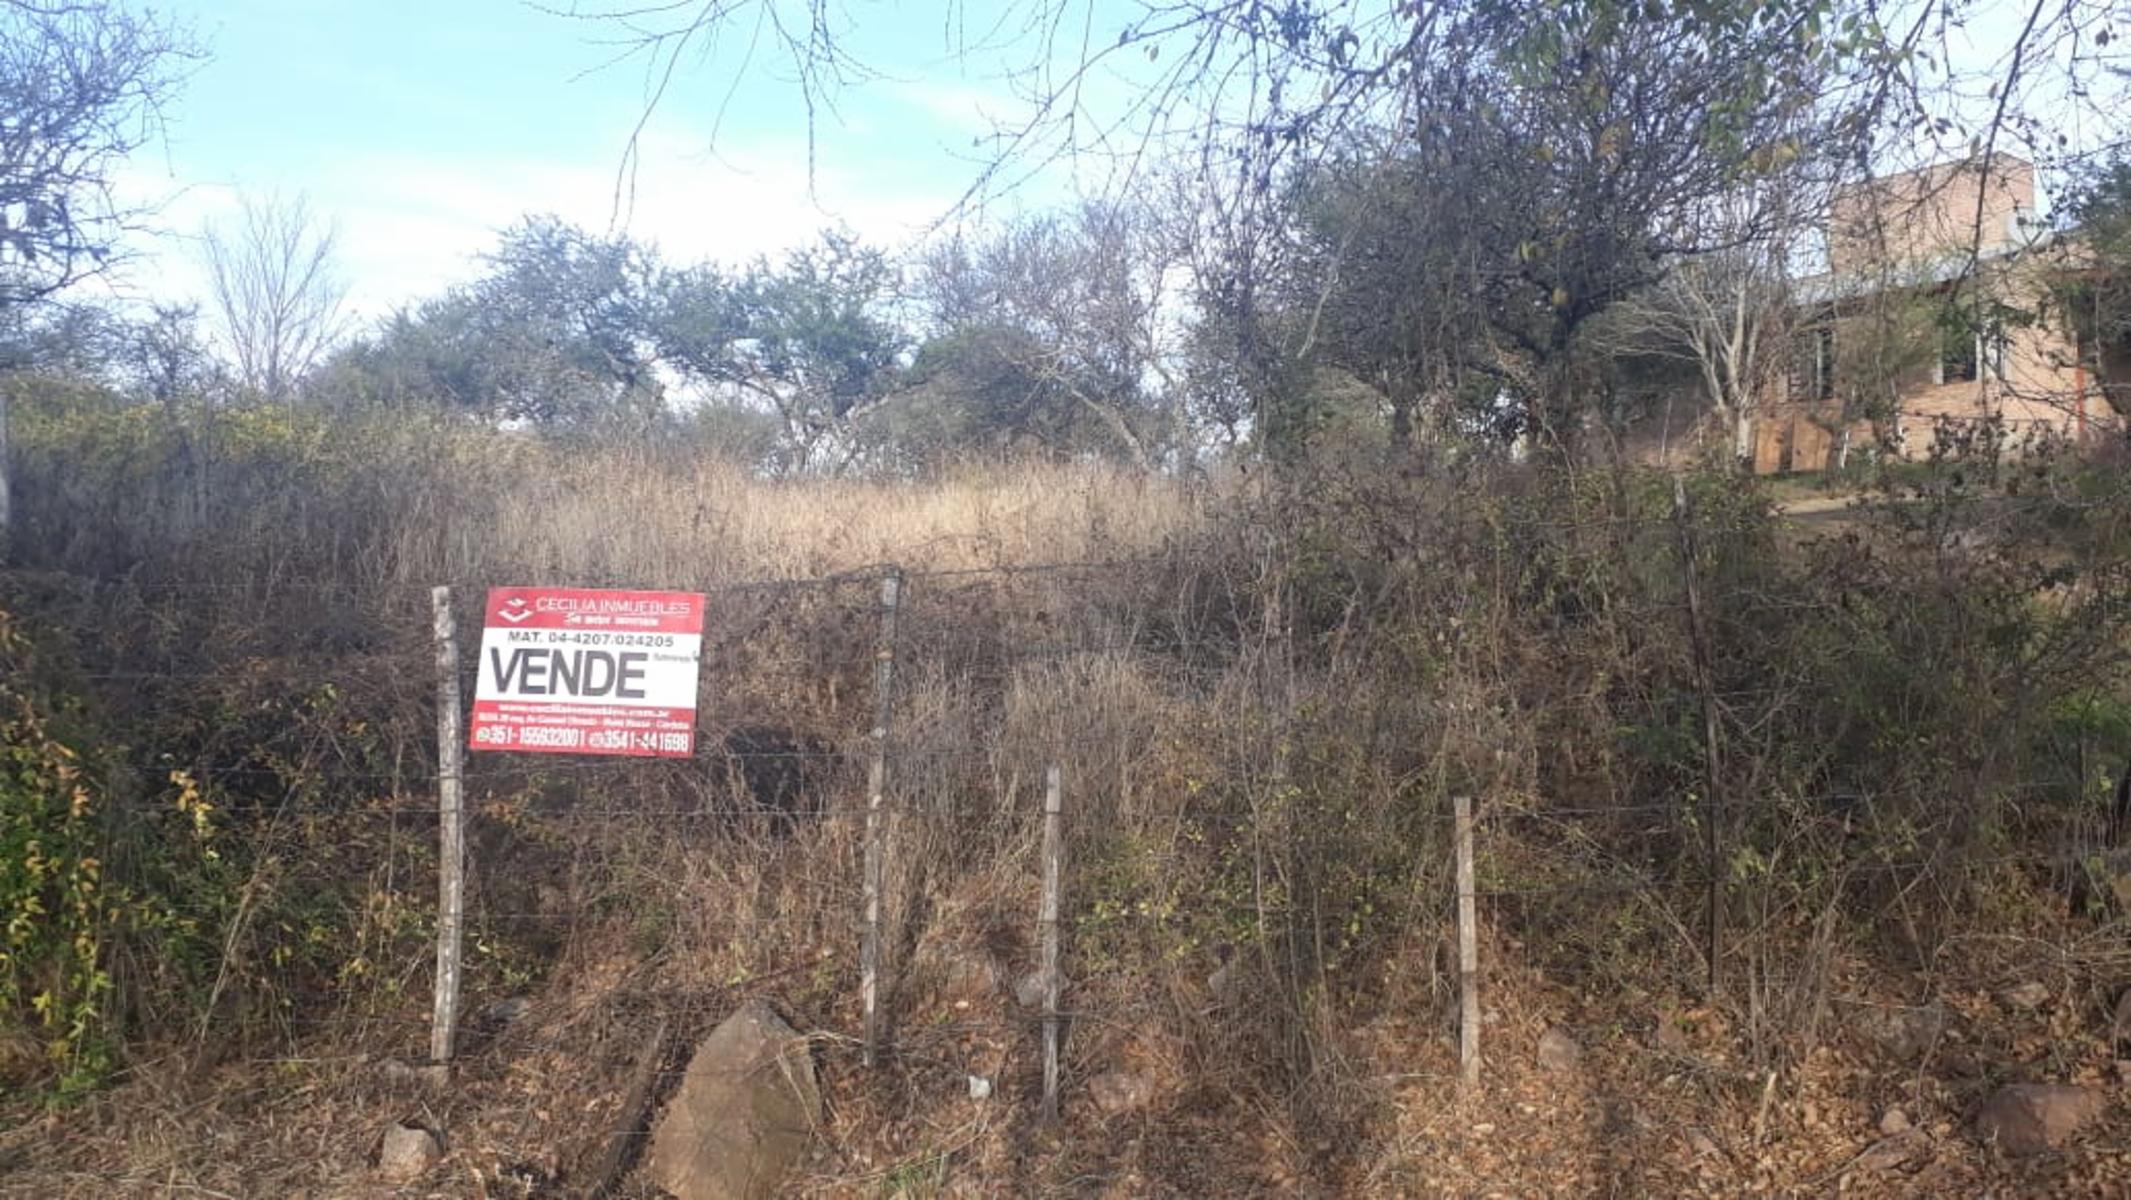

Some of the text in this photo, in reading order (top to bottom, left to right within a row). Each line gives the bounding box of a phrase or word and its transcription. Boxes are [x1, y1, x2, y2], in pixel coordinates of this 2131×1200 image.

[536, 597, 691, 615] CECILIA INMUEBLES
[508, 630, 543, 643] MAT.
[489, 646, 649, 699] VENDE
